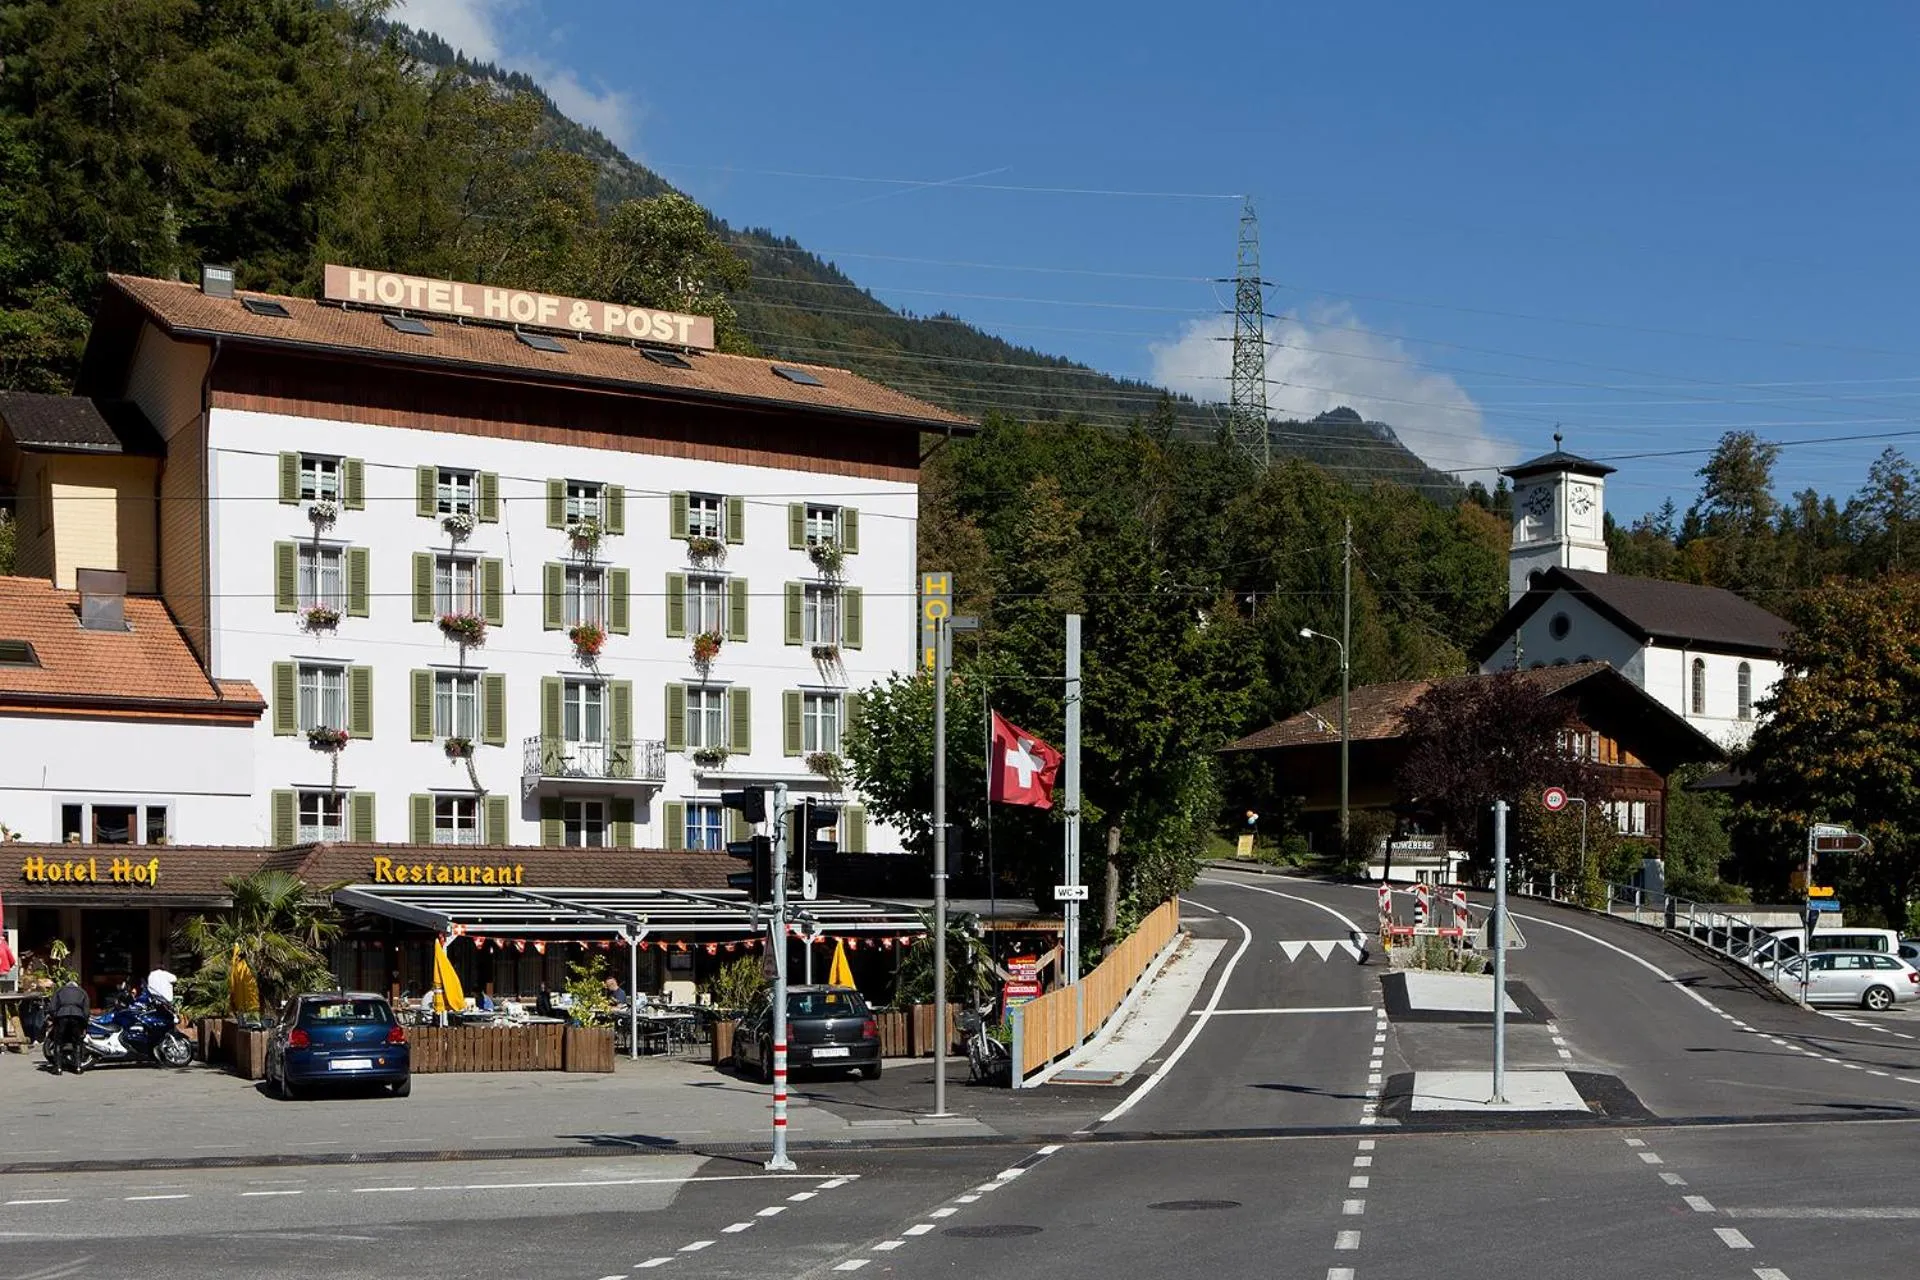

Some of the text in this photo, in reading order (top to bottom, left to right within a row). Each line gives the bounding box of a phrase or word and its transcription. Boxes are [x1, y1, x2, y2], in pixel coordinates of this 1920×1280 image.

[349, 269, 694, 343] HOTEL HOF & POST
[22, 856, 160, 887] Hotel Hof
[372, 855, 525, 885] Restaurant
[1058, 888, 1073, 897] WC
